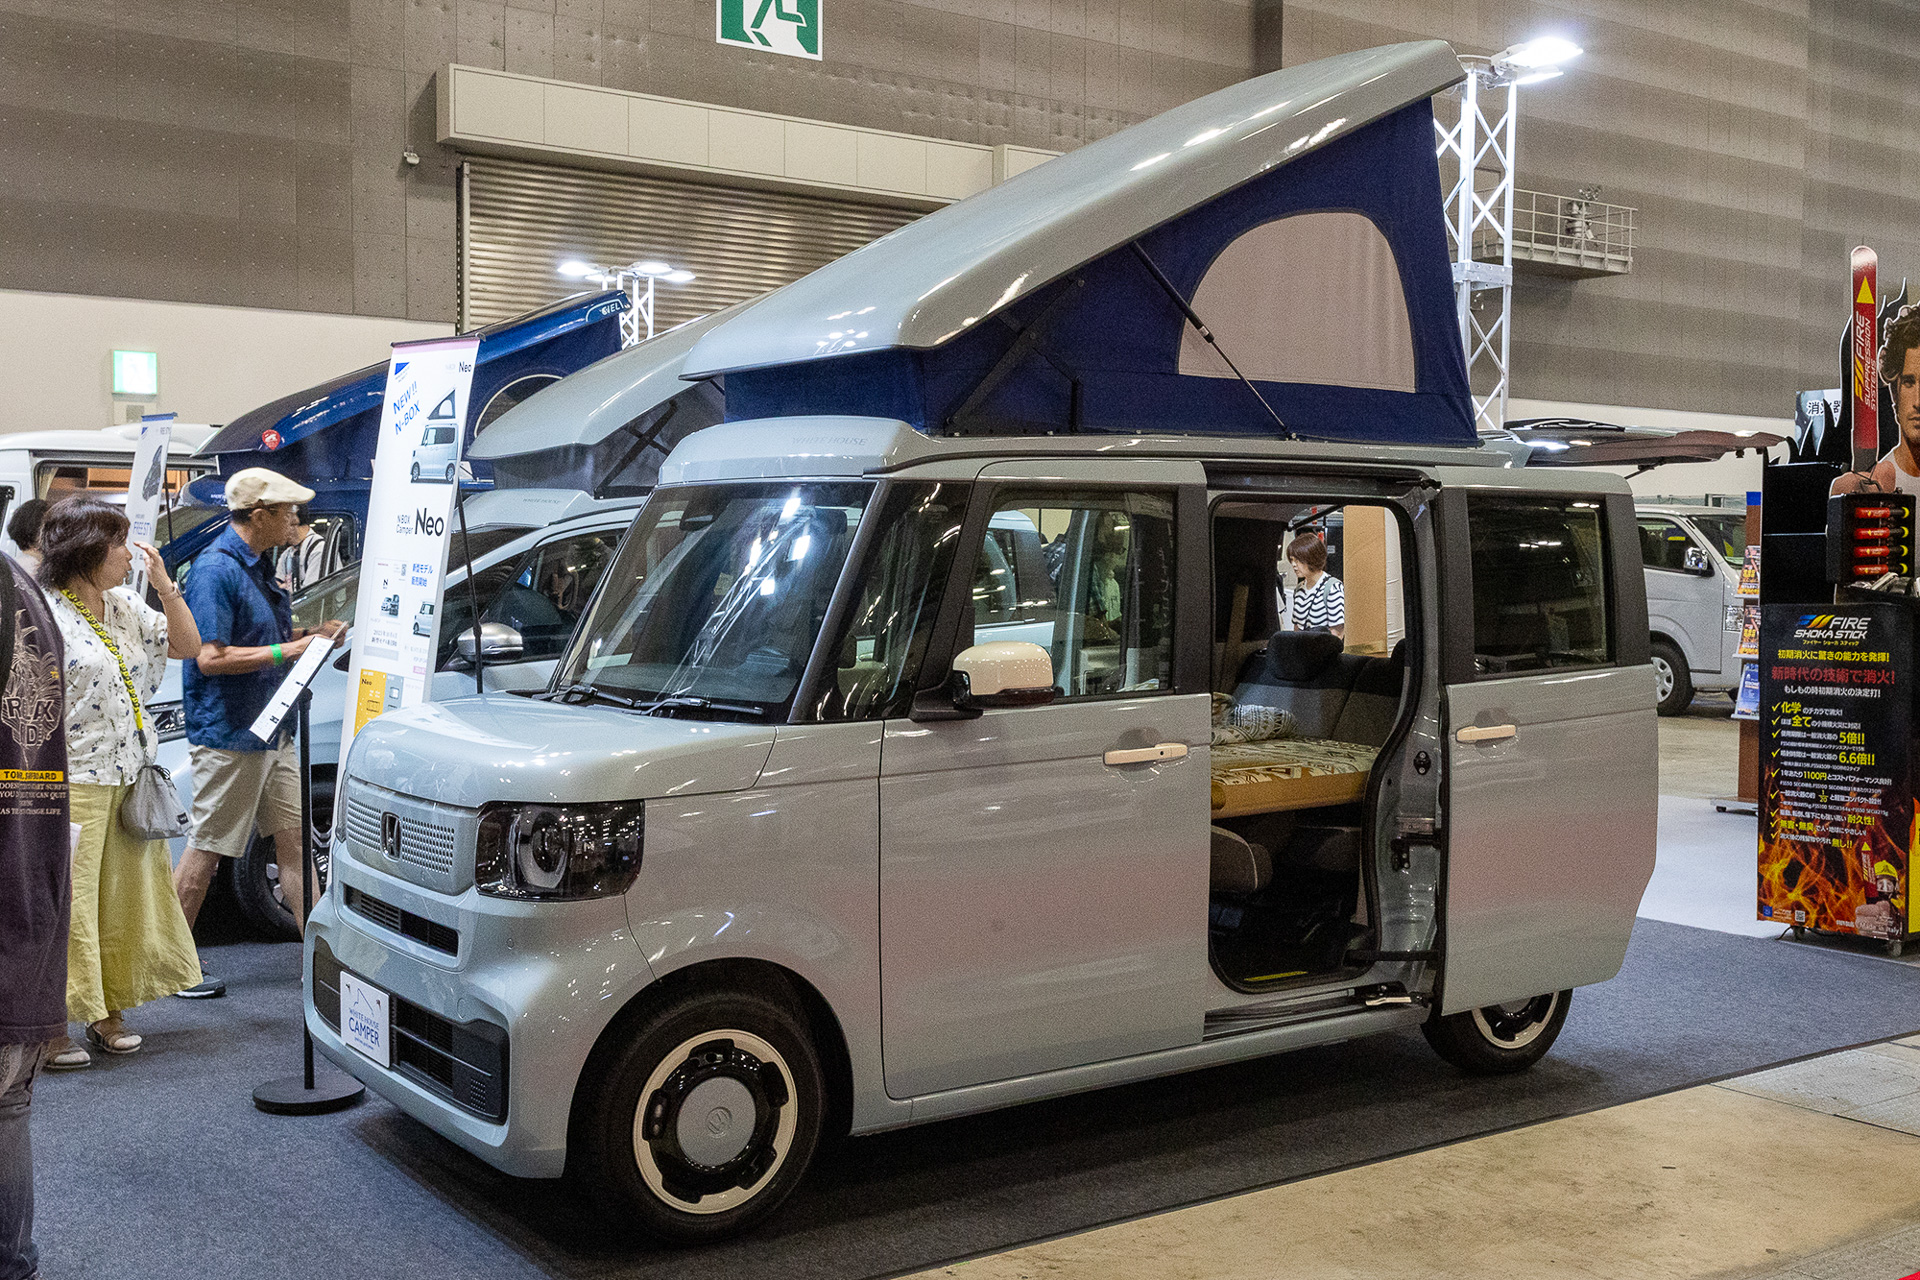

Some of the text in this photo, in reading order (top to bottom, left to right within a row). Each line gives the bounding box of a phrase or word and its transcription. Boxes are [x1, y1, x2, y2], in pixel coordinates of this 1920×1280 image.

[1855, 311, 1865, 360] FIRE
[459, 361, 472, 372] Neo
[395, 400, 420, 435] N-BOX
[414, 507, 445, 537] Neo
[396, 524, 414, 535] Camper
[1829, 616, 1871, 629] FIRE
[1793, 629, 1868, 639] SHOKA STICK
[1778, 649, 1890, 662] 初期消火に驚きの能力を発揮!
[1771, 666, 1895, 685] 新時代の技術で消火!
[1784, 685, 1881, 698] もしもの時初期消火の決定打!
[348, 1016, 380, 1048] CAMPER
